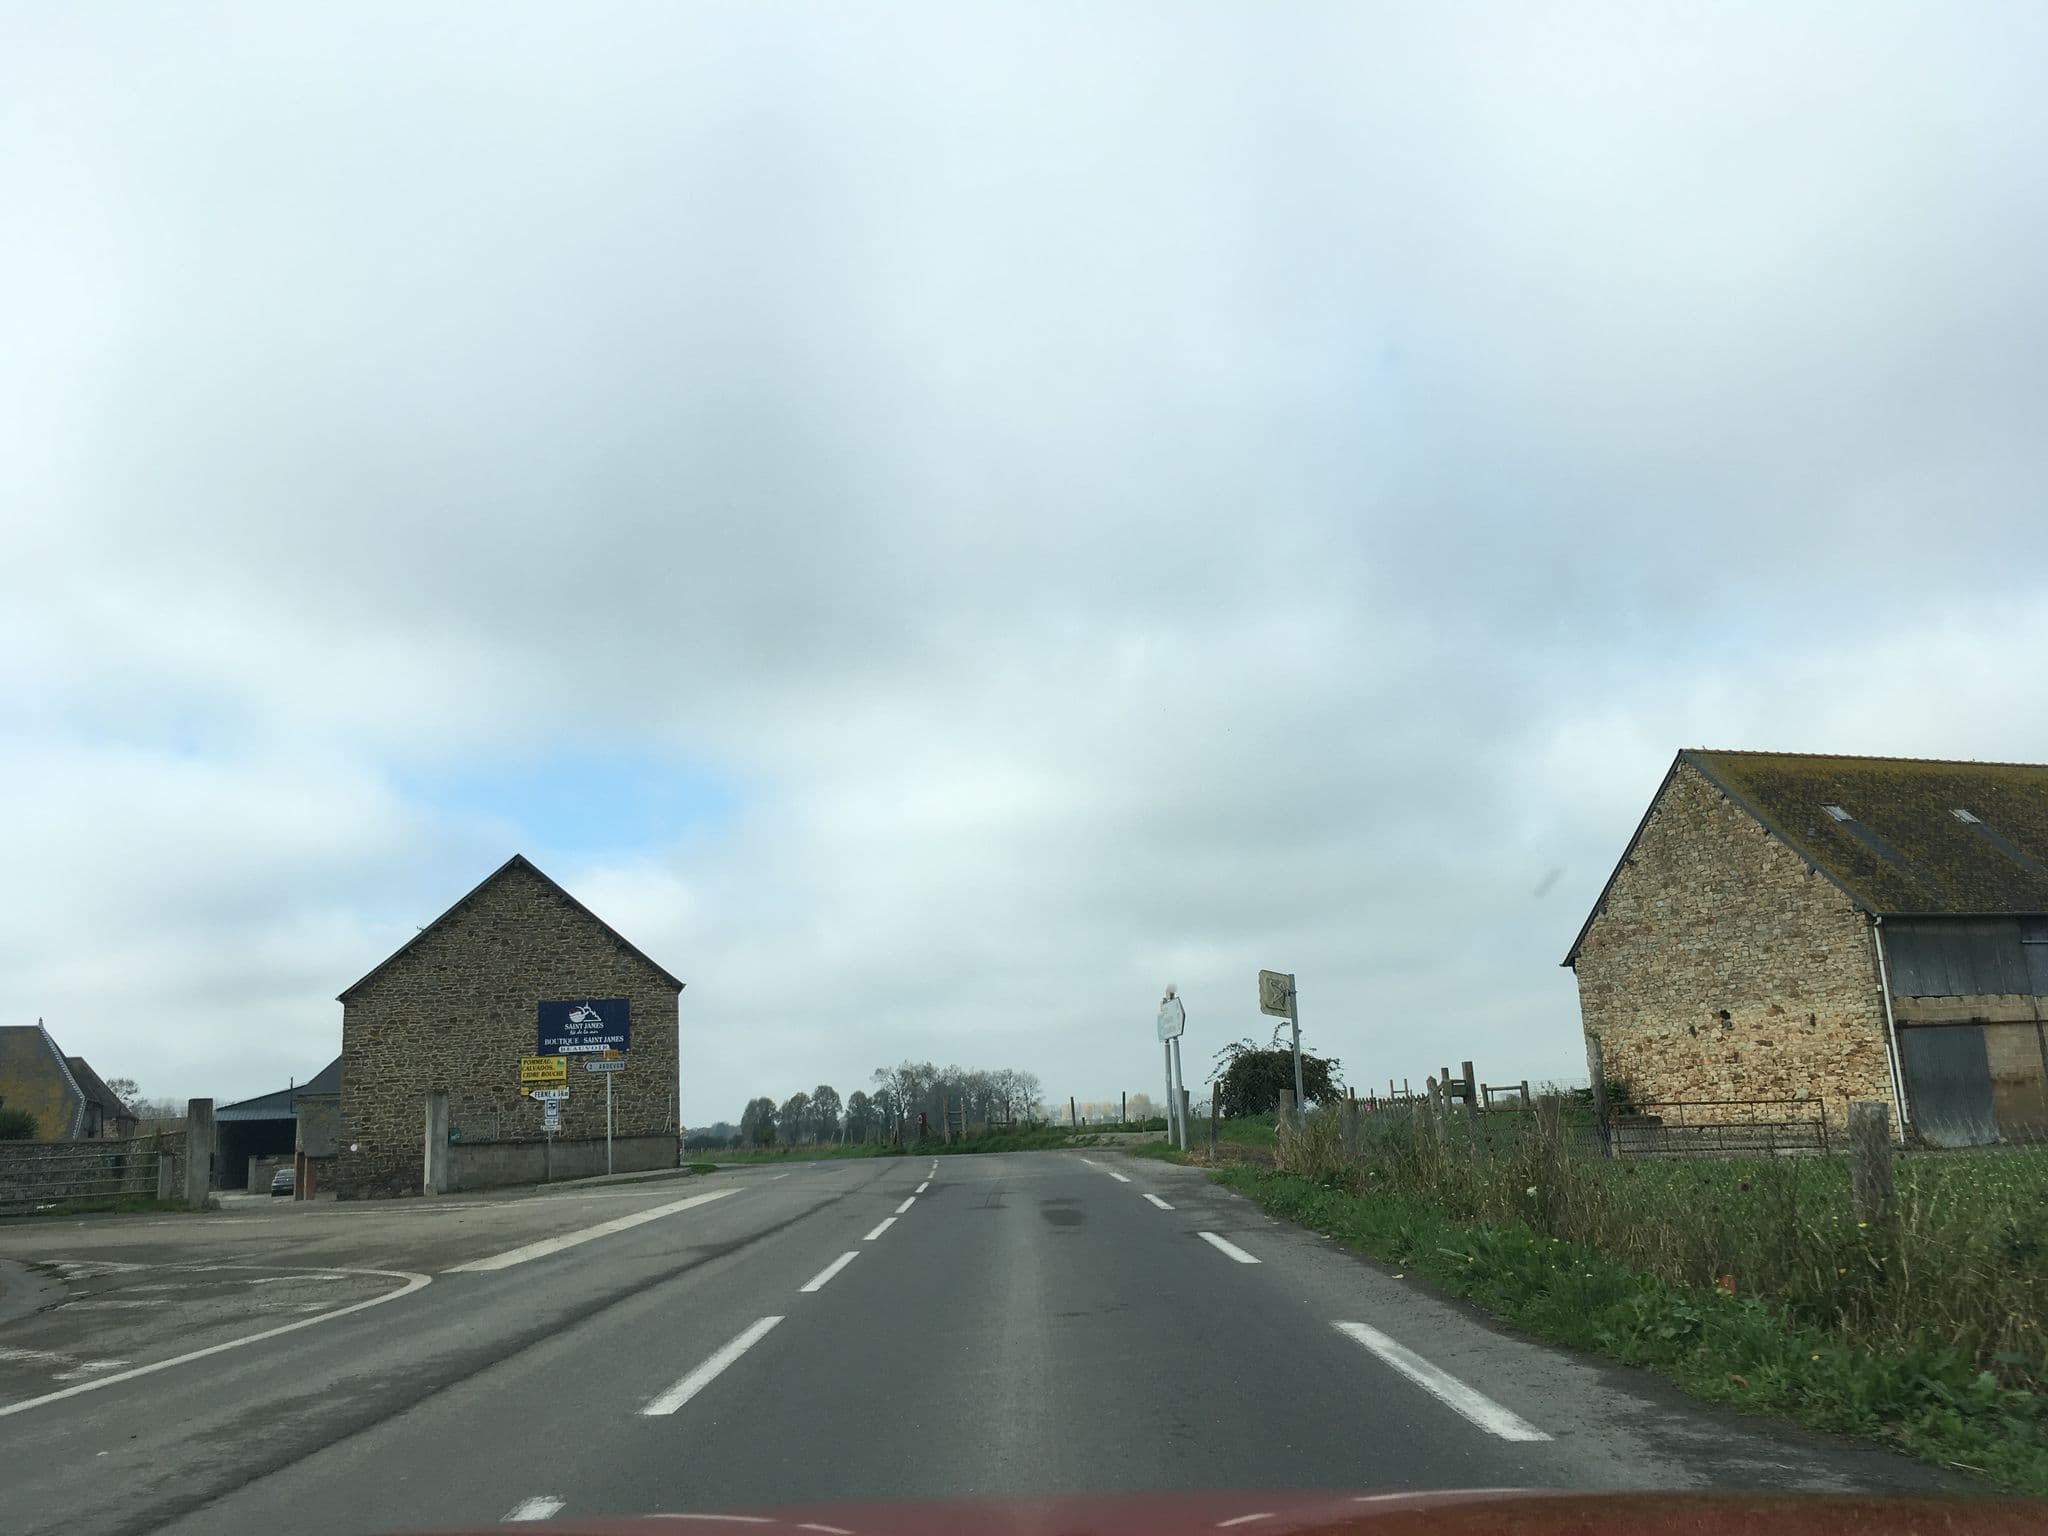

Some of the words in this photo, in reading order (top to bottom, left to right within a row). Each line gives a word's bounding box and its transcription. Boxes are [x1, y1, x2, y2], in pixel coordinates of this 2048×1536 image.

[544, 1037, 579, 1045] BOUTIQUE
[583, 1036, 603, 1044] SAINT
[603, 1035, 624, 1043] JAMES
[534, 1090, 552, 1098] FERME
